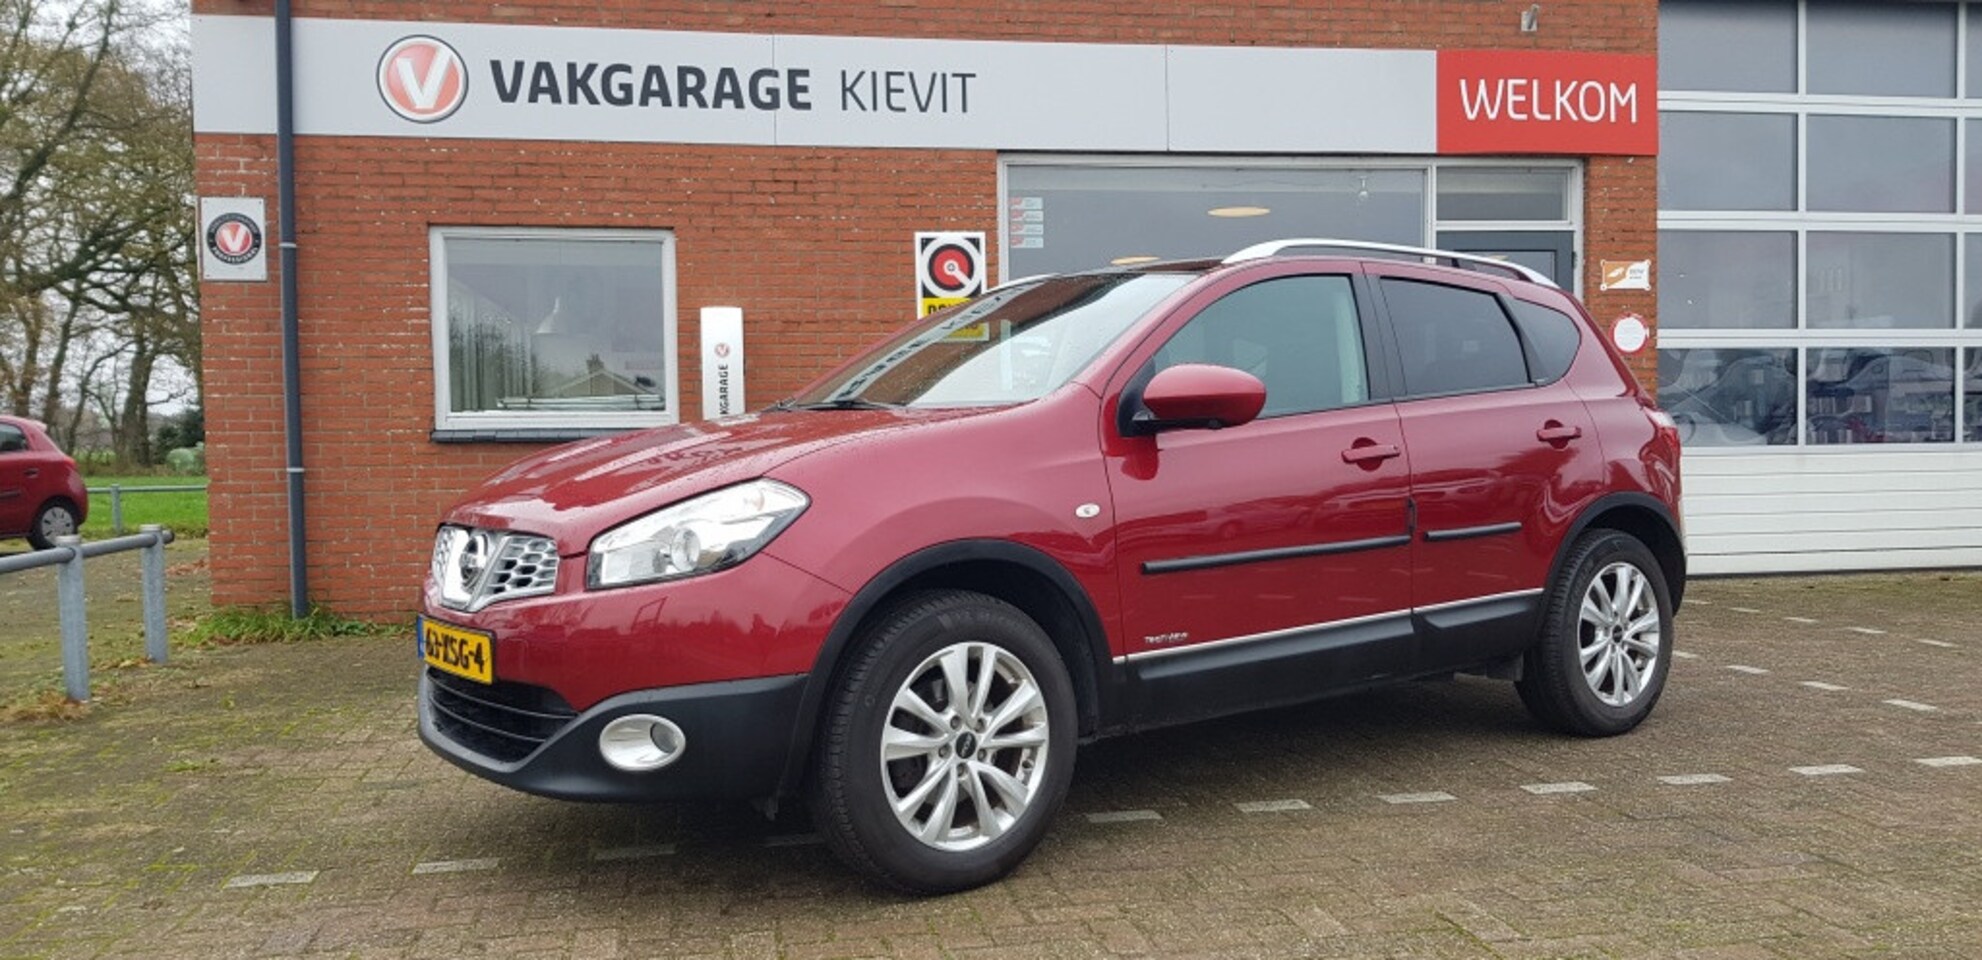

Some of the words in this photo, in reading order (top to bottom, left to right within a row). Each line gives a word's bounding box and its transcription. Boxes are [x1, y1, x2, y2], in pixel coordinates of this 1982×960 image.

[396, 47, 452, 109] V
[489, 59, 812, 111] VAKGARAGE
[840, 69, 977, 114] KIEVIT
[1459, 78, 1638, 123] WELKOM
[718, 363, 729, 415] KGARAGE
